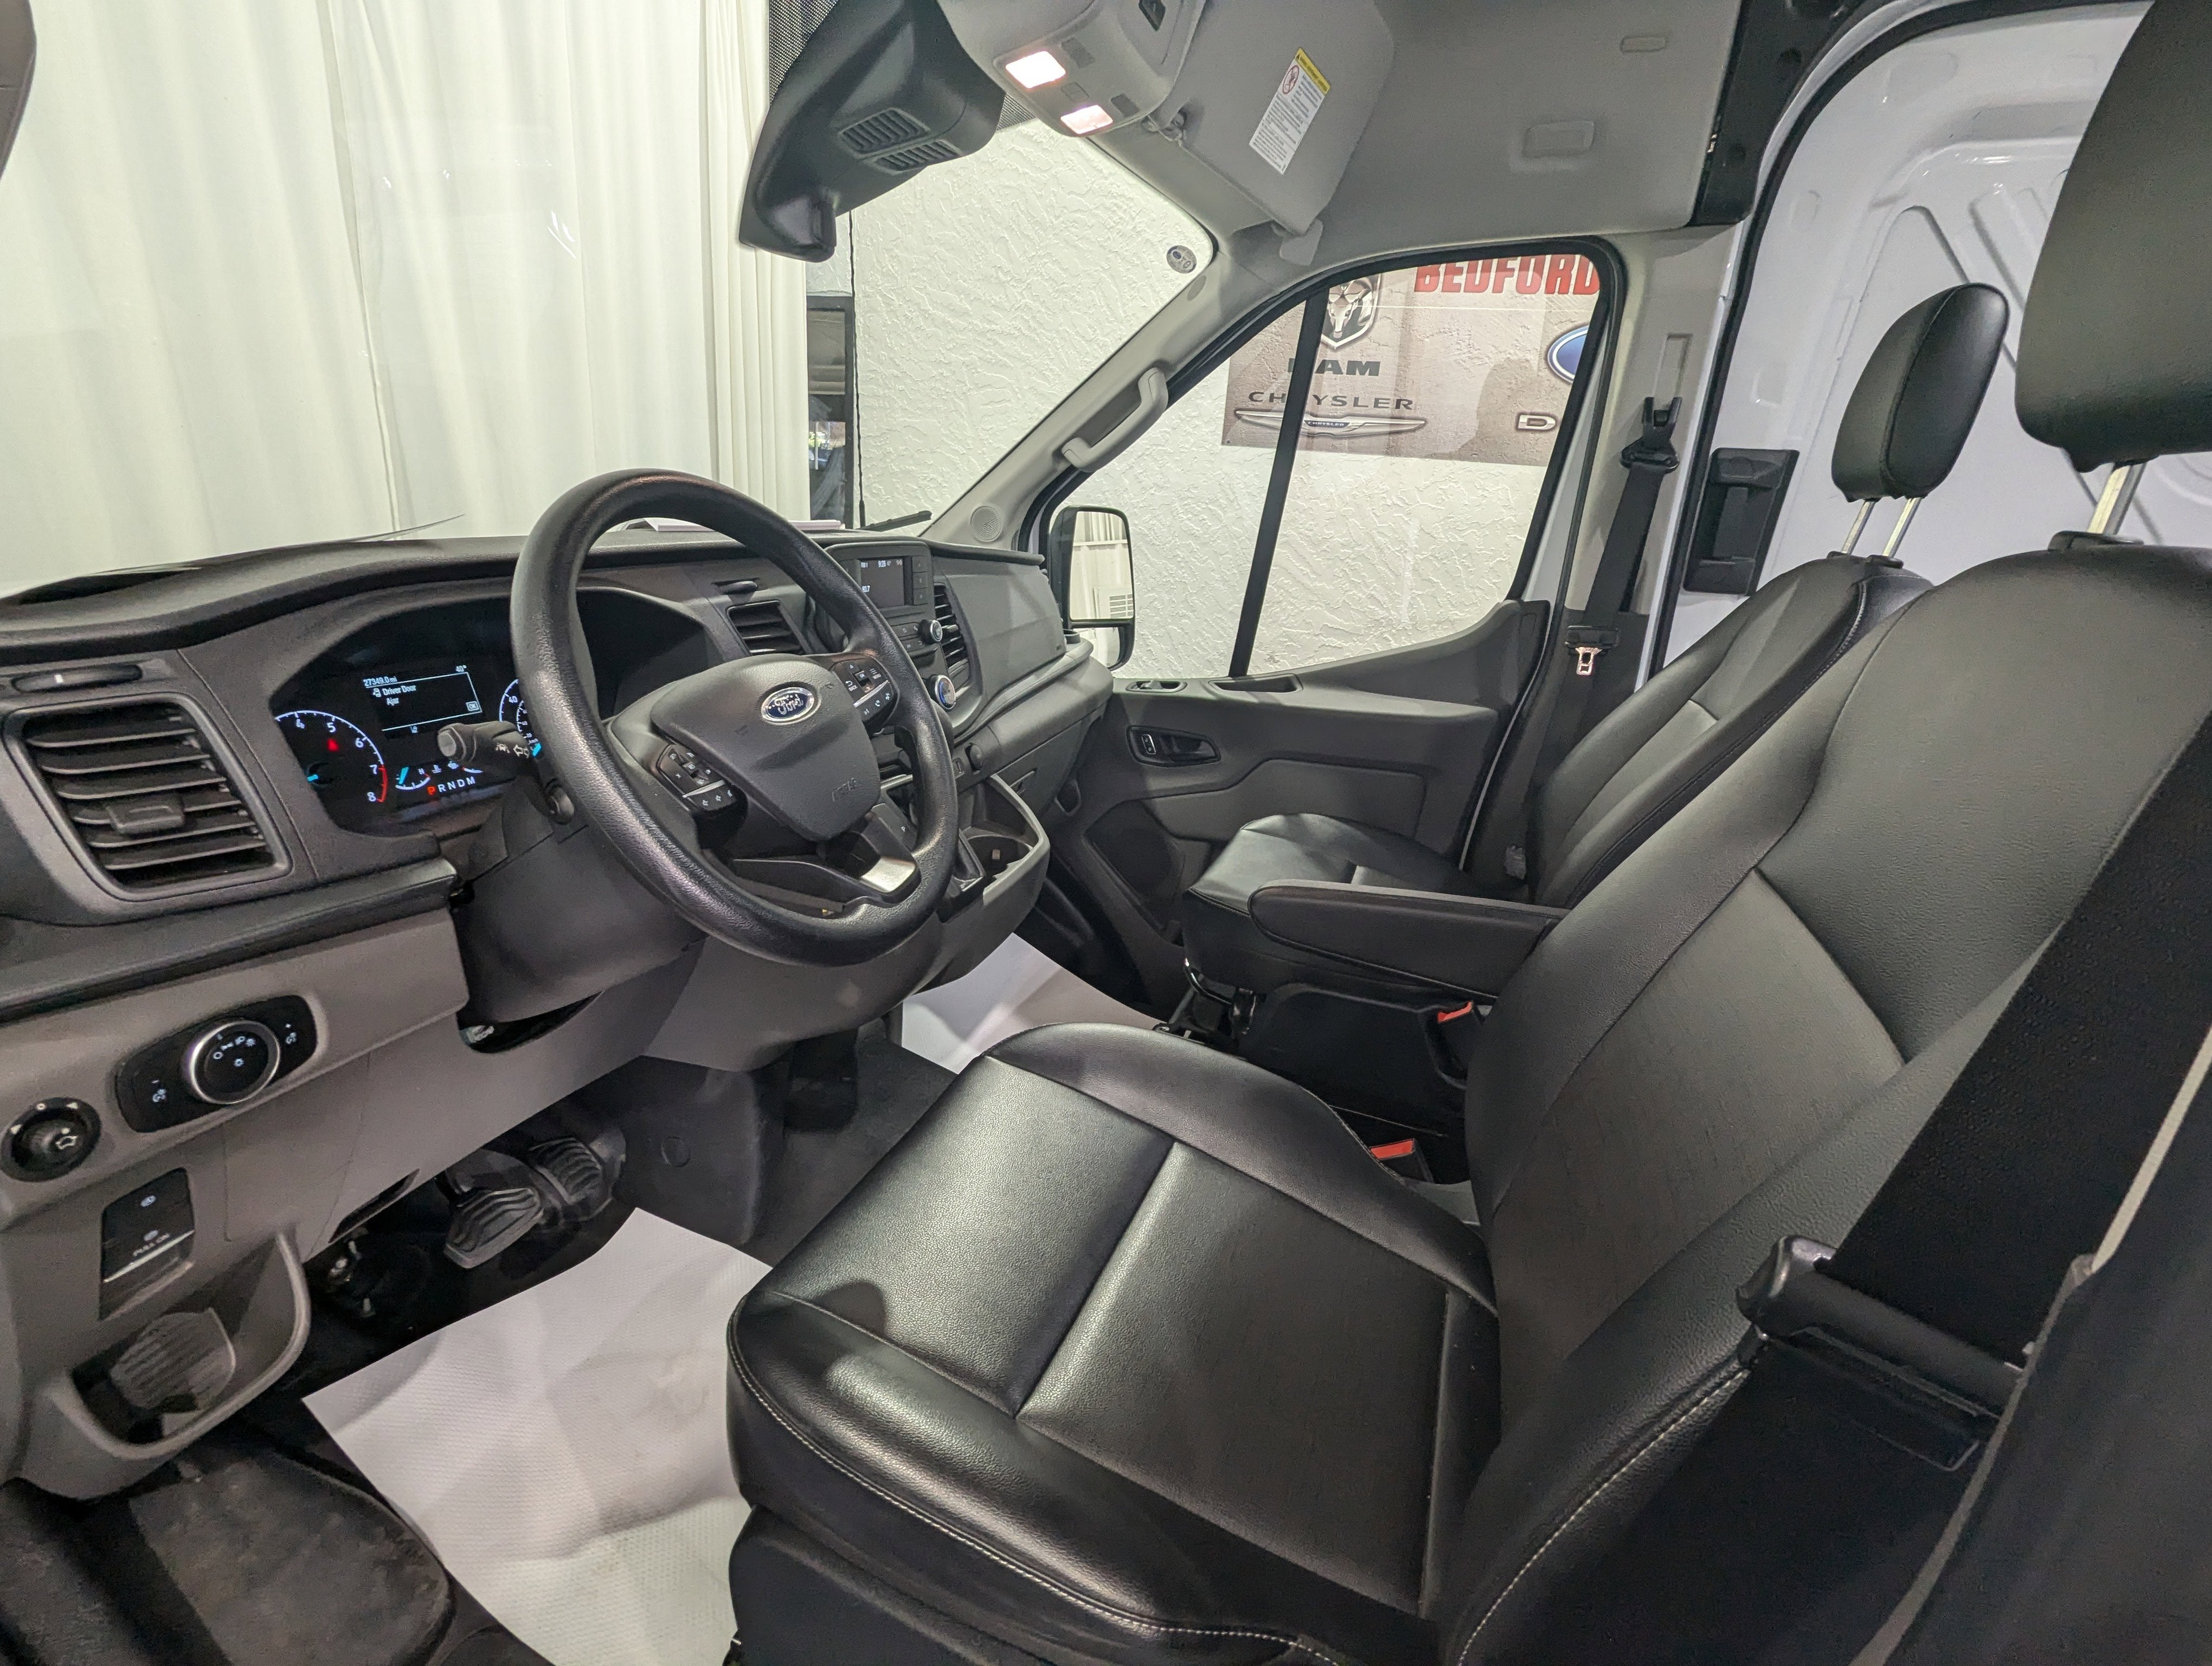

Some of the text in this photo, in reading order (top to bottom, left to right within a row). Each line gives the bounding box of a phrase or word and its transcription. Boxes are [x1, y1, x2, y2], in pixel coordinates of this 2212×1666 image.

[1414, 254, 1600, 295] BEDFORD
[1288, 358, 1381, 377] AM
[1249, 391, 1414, 411] CHYSLER
[382, 688, 401, 696] Driver
[386, 697, 400, 706] Ajar
[774, 694, 803, 715] Ford
[295, 719, 305, 729] 4
[326, 722, 336, 733] 5
[355, 738, 364, 748] 6
[369, 764, 377, 775] 7
[366, 791, 377, 802] 8
